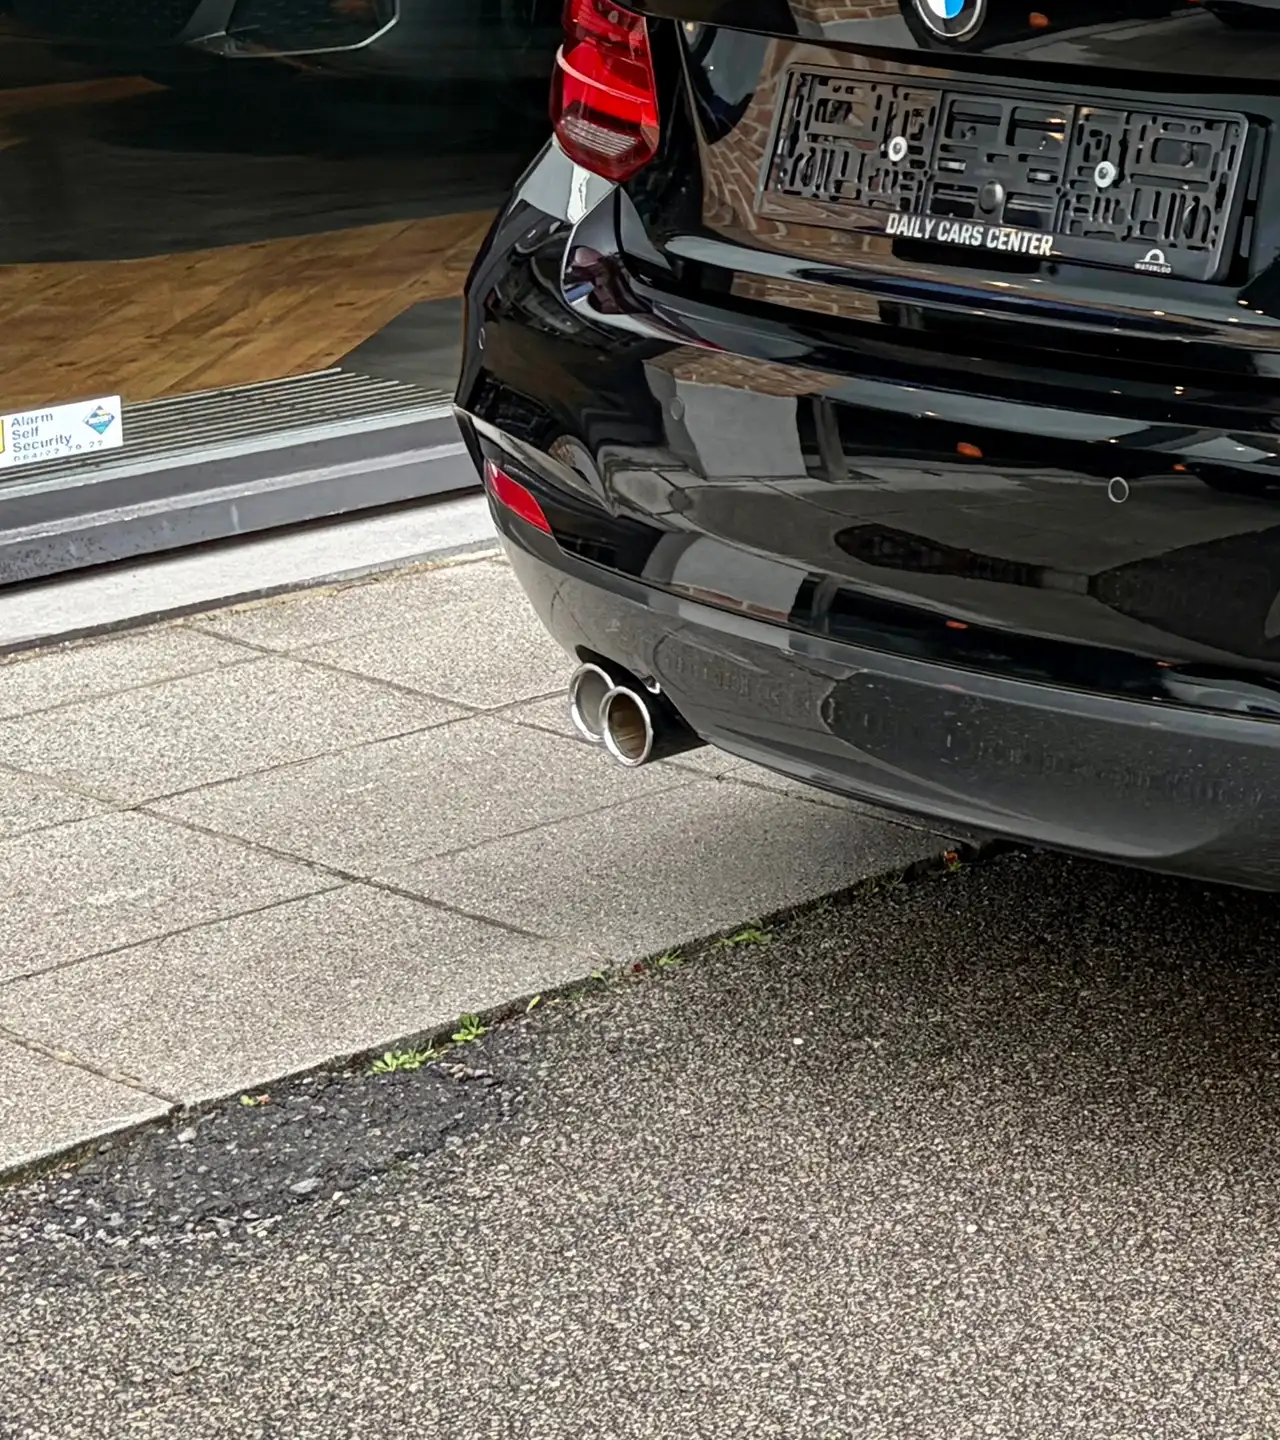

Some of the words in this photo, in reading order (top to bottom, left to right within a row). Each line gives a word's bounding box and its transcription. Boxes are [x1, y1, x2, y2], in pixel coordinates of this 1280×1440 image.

[885, 212, 933, 241] DAILY
[937, 220, 983, 247] CARS
[987, 227, 1054, 257] CENTER
[11, 413, 54, 428] Alarm
[11, 425, 39, 441] Self
[12, 434, 72, 453] Security
